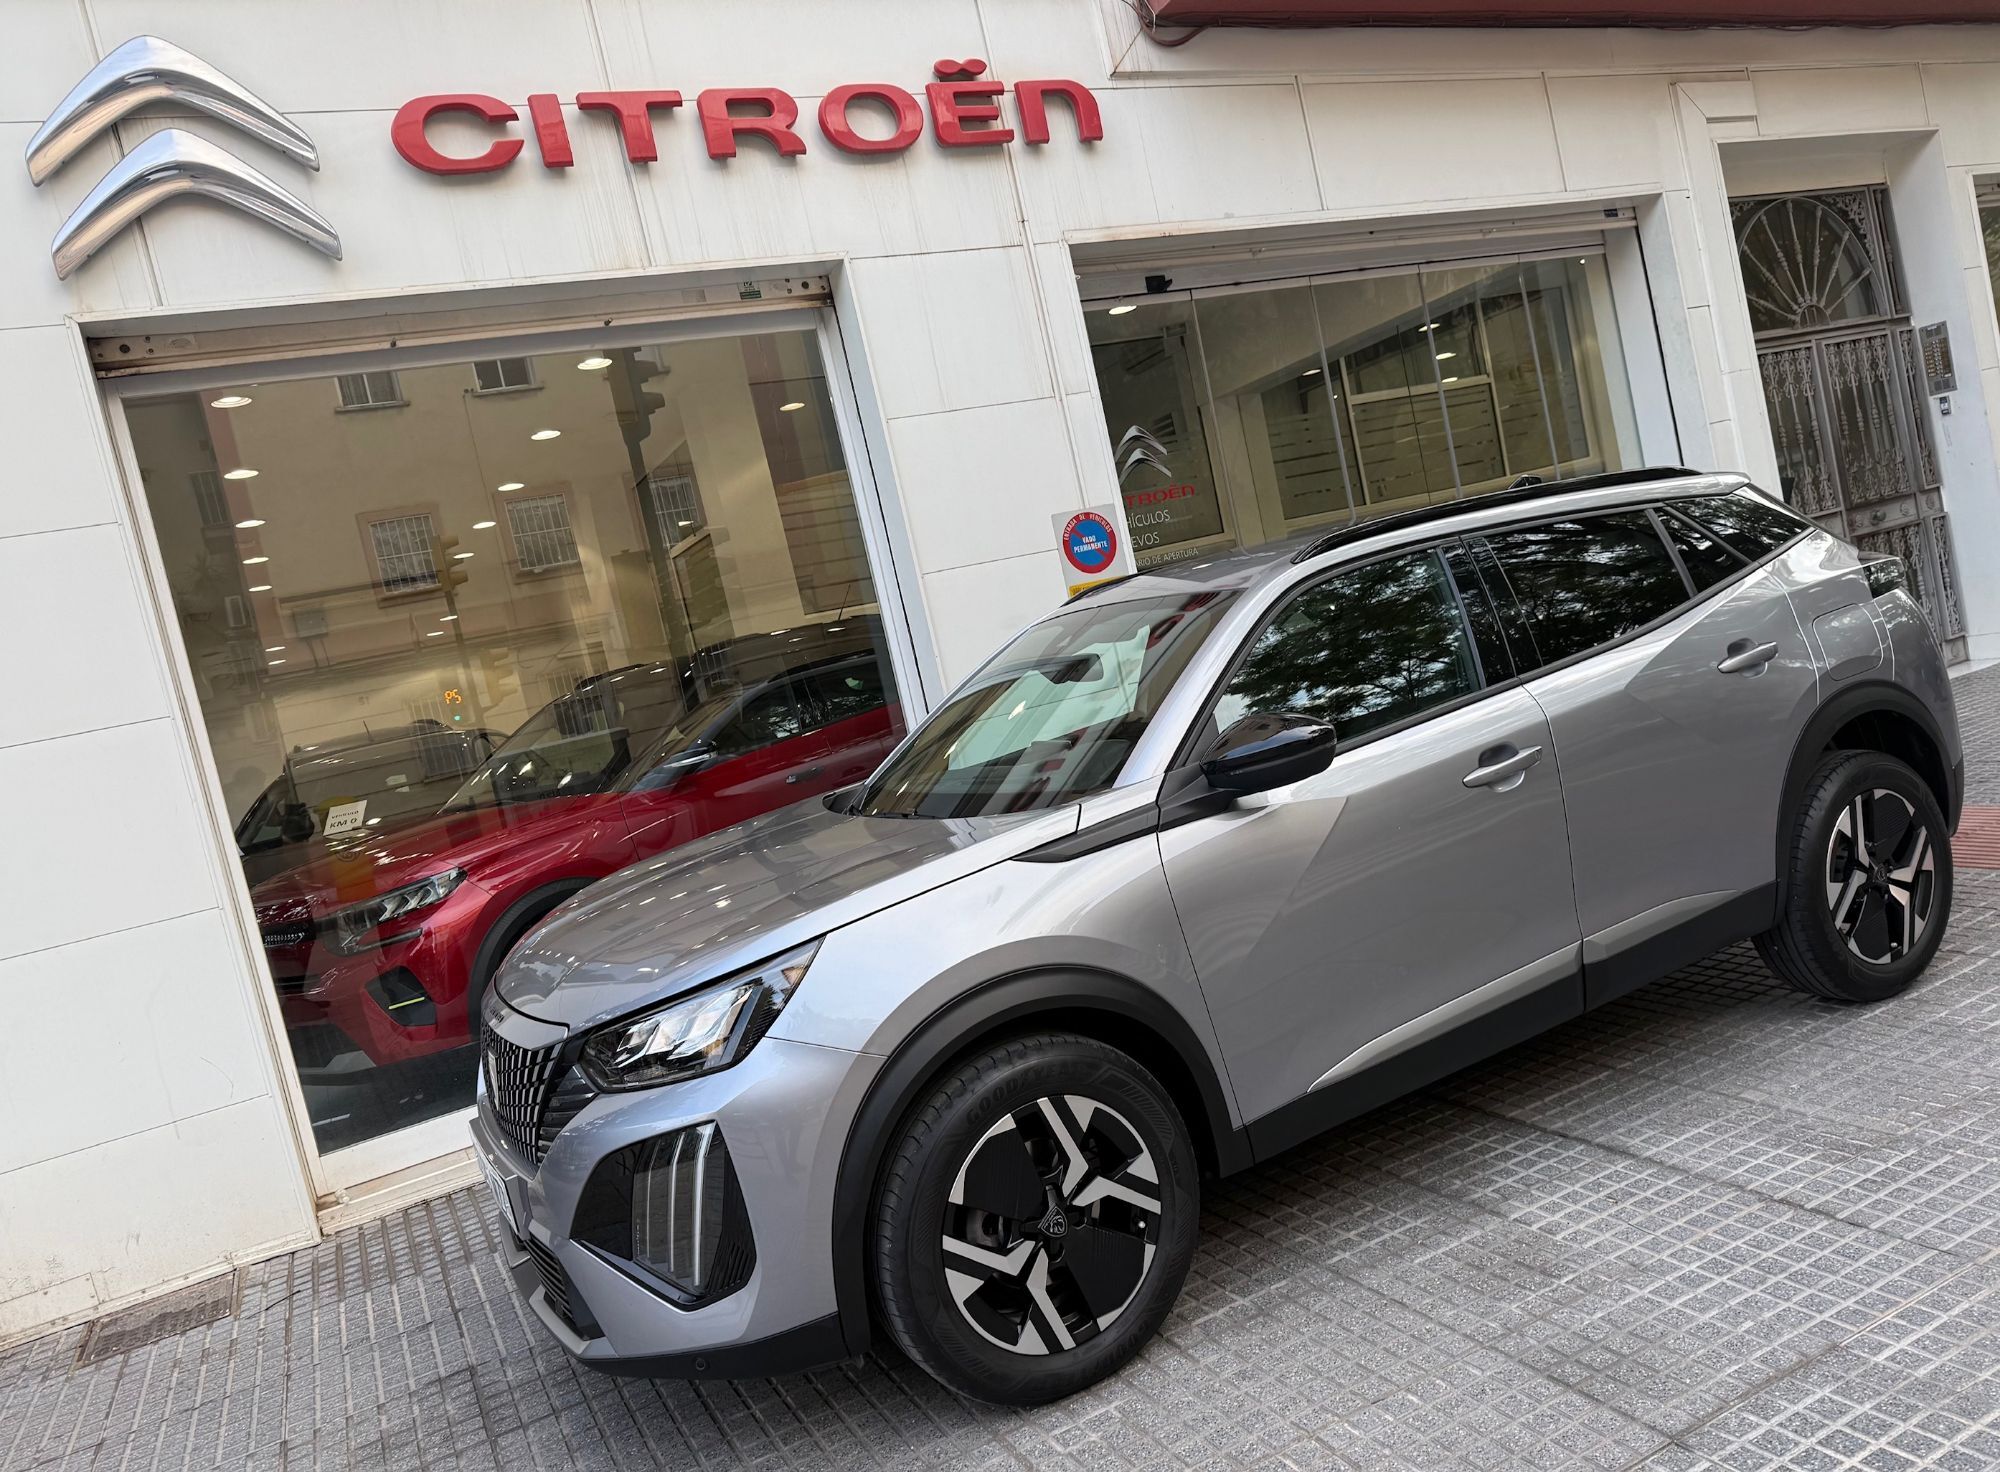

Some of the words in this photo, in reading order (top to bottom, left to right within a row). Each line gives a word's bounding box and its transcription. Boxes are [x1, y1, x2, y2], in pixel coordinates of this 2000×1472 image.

[1124, 483, 1195, 508] TROËN
[1127, 510, 1171, 529] HÍCULOS
[1063, 518, 1077, 541] ENTRADA
[1073, 540, 1108, 554] PERMANENTE
[1082, 535, 1097, 544] VADO
[1131, 531, 1160, 548] EVOS
[1152, 555, 1162, 564] DE
[1163, 547, 1199, 562] APERTURA
[329, 819, 348, 829] KM
